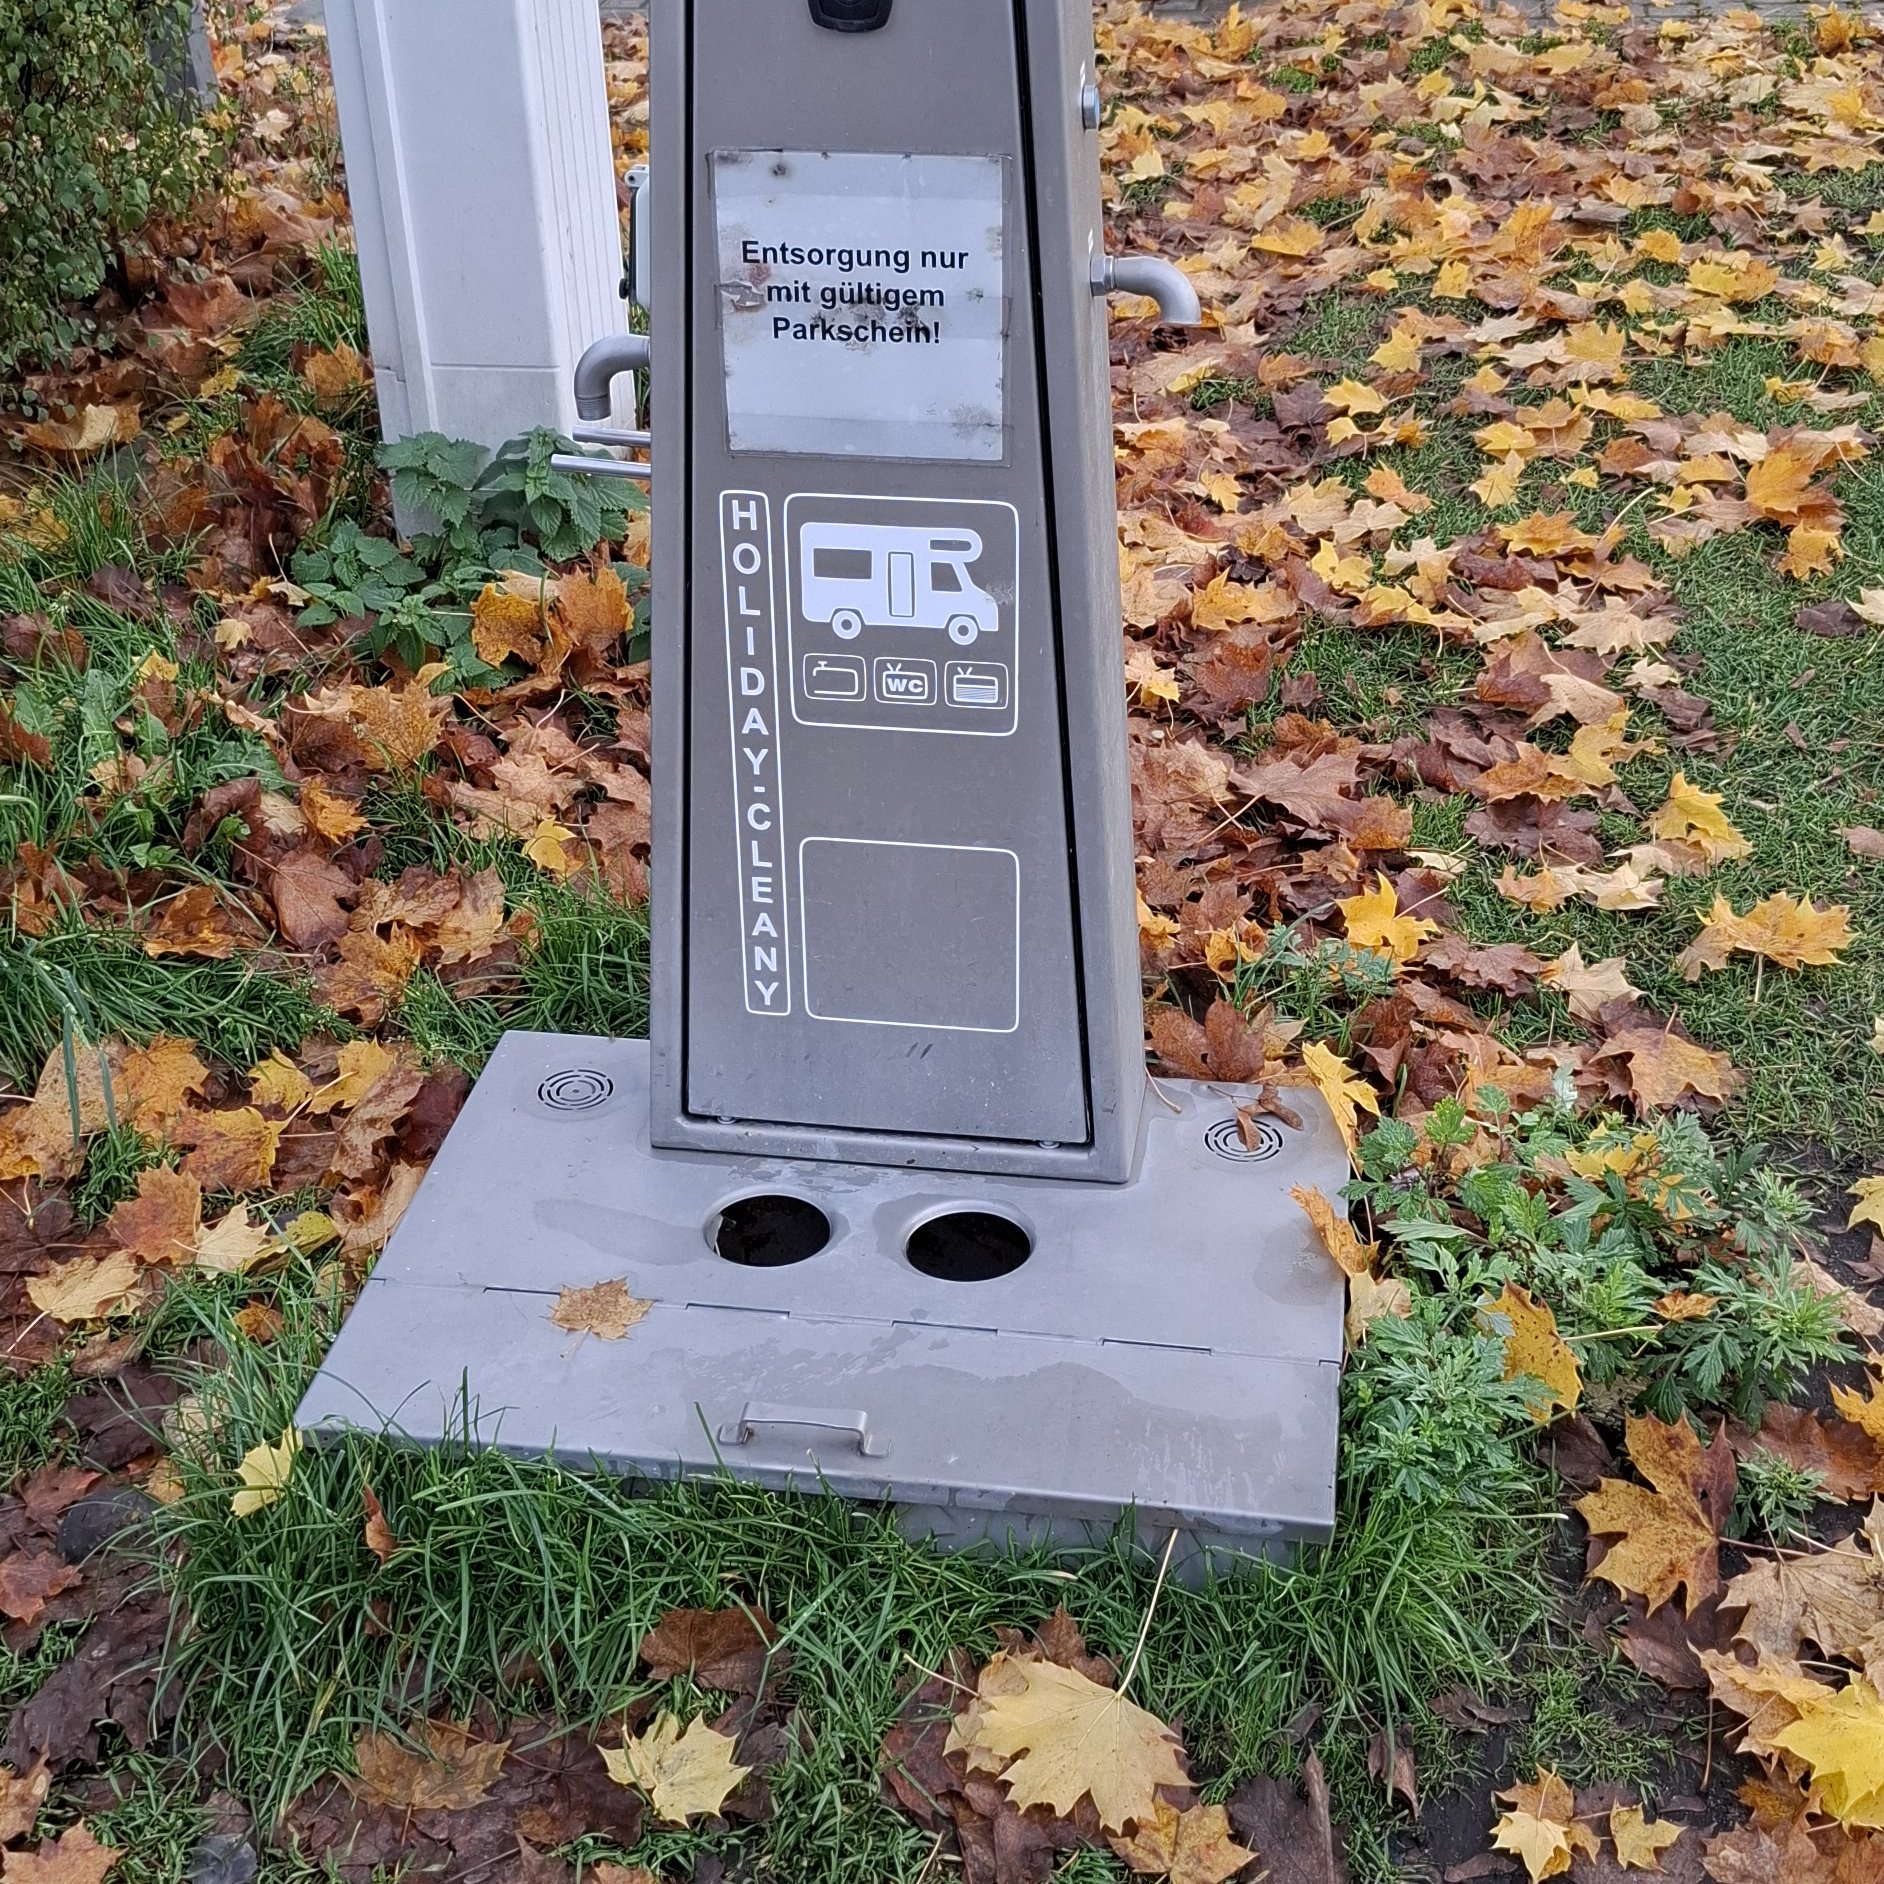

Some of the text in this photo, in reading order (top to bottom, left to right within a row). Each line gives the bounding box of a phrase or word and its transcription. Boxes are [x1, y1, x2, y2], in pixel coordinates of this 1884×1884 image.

[742, 240, 969, 273] Entsorgung nur
[767, 280, 944, 310] mit gültigem
[772, 316, 940, 344] Parkschein!
[887, 678, 924, 693] WC
